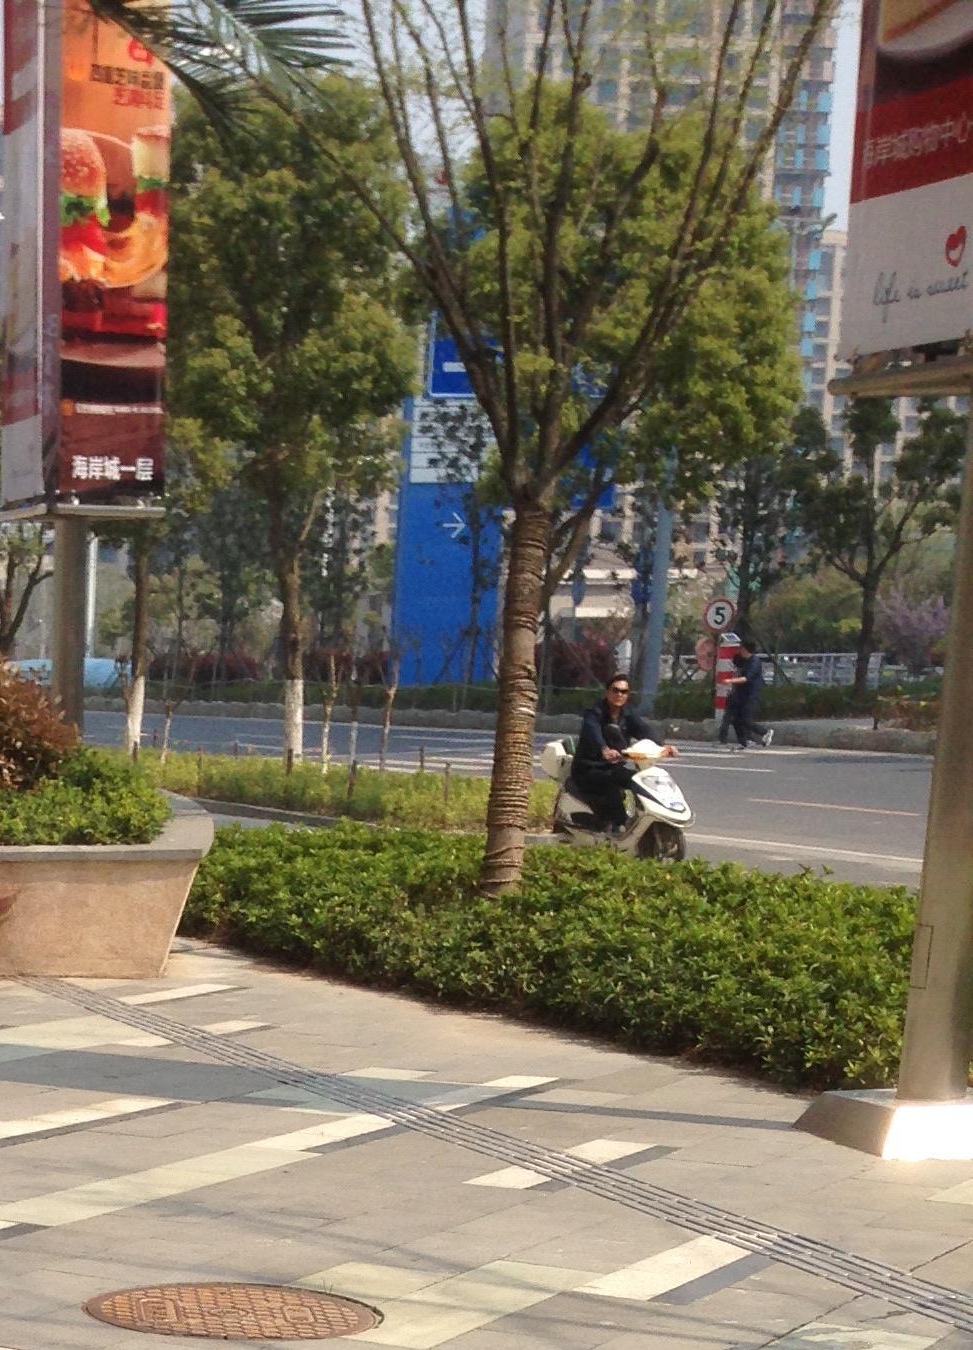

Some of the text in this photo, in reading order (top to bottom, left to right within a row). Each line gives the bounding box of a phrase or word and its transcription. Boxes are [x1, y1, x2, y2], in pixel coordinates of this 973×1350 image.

[71, 454, 154, 481] 海岸城一层
[713, 606, 726, 626] 5
